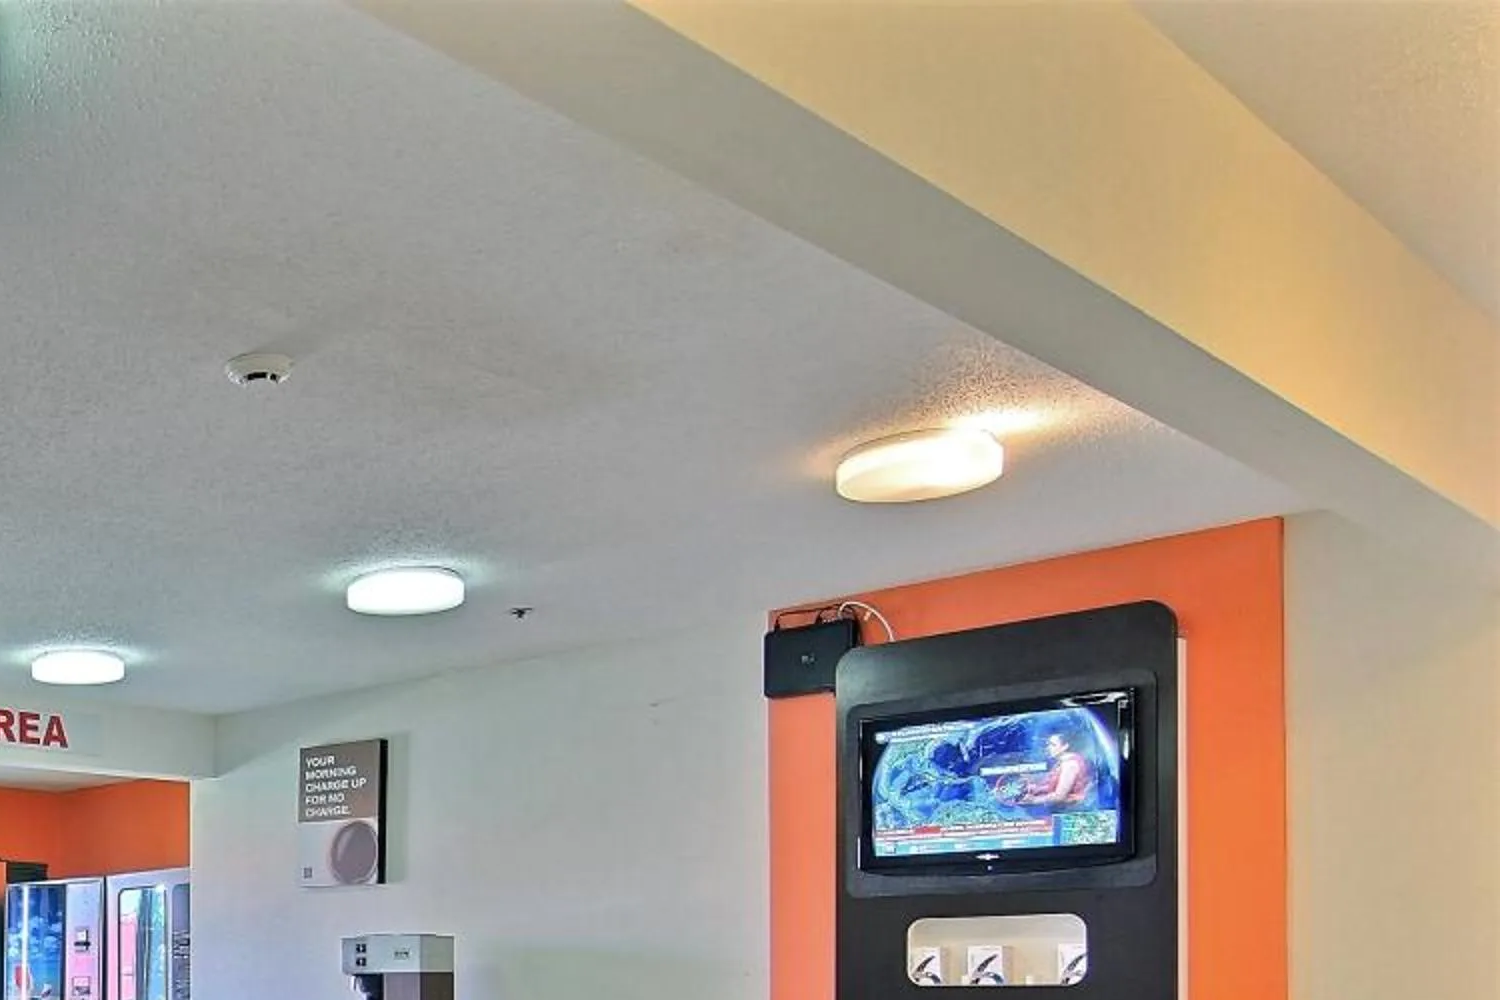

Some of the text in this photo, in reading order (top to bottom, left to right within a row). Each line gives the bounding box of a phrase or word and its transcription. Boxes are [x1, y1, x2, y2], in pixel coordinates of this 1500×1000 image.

[306, 756, 334, 767] YOUR
[305, 766, 357, 780] MORNING
[305, 777, 367, 792] CHARGE UP
[305, 792, 345, 804] FOR NO
